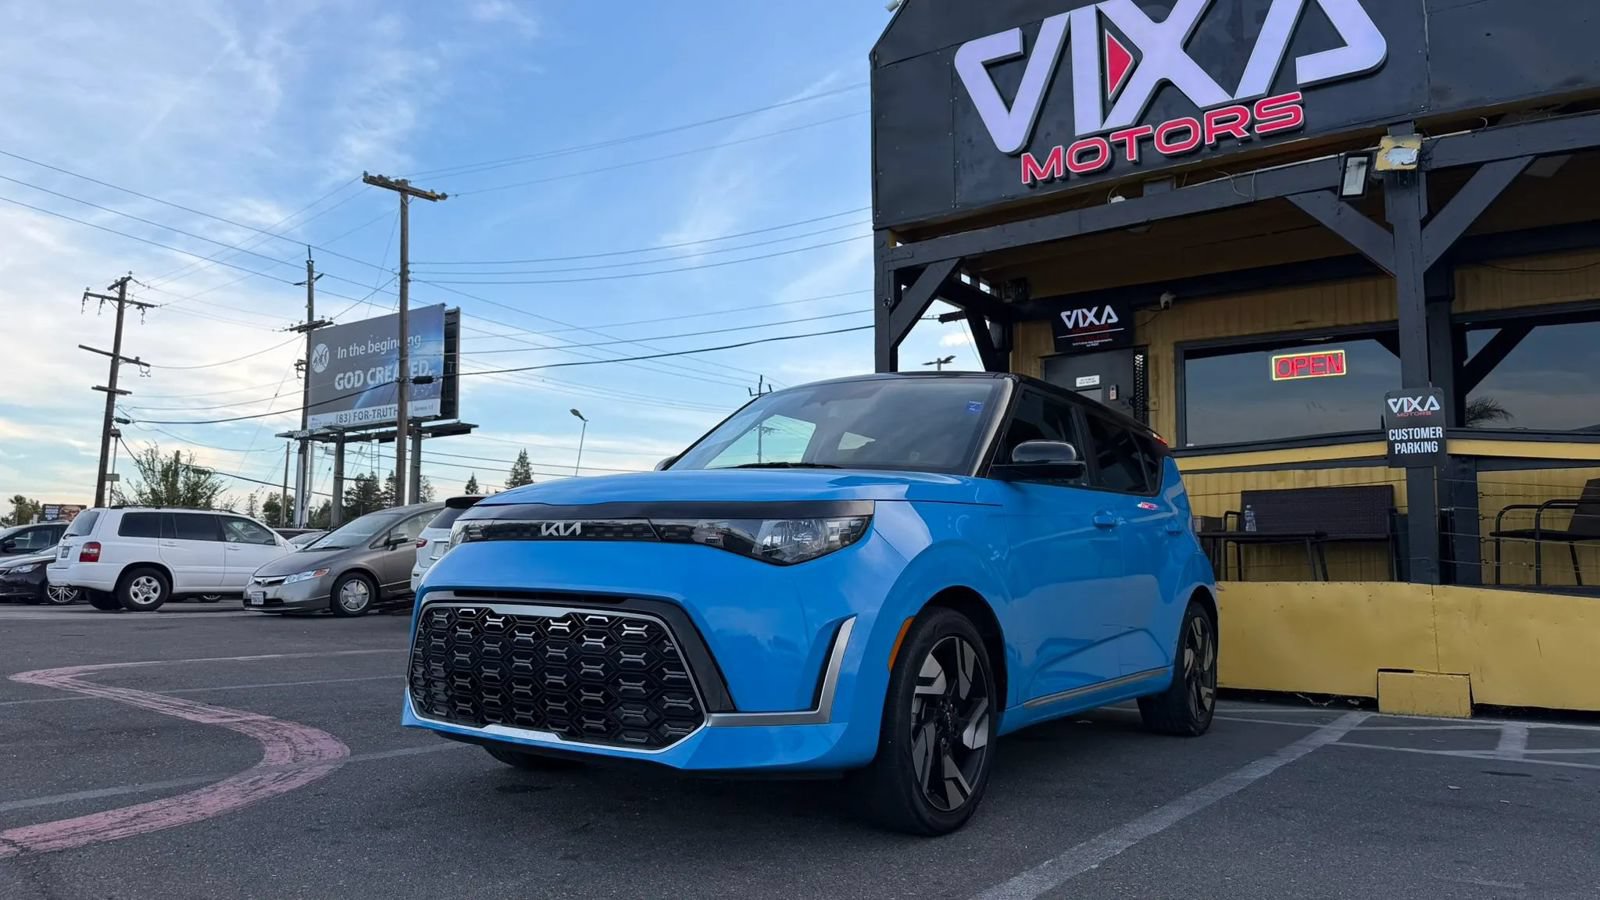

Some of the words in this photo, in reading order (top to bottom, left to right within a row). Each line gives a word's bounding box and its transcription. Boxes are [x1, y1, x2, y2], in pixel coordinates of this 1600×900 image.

[954, 0, 1388, 155] VIXA
[1021, 91, 1304, 185] MOTORS
[1060, 304, 1119, 329] VIXA
[337, 346, 346, 359] In
[350, 342, 366, 357] the
[367, 335, 421, 355] beginng
[1276, 353, 1343, 378] OPEN
[335, 370, 364, 391] GOD
[1387, 395, 1441, 413] VIXA
[335, 412, 351, 424] (83)
[1388, 426, 1443, 441] CUSTOMER
[1394, 441, 1438, 455] PARKING
[540, 521, 582, 537] KIA
